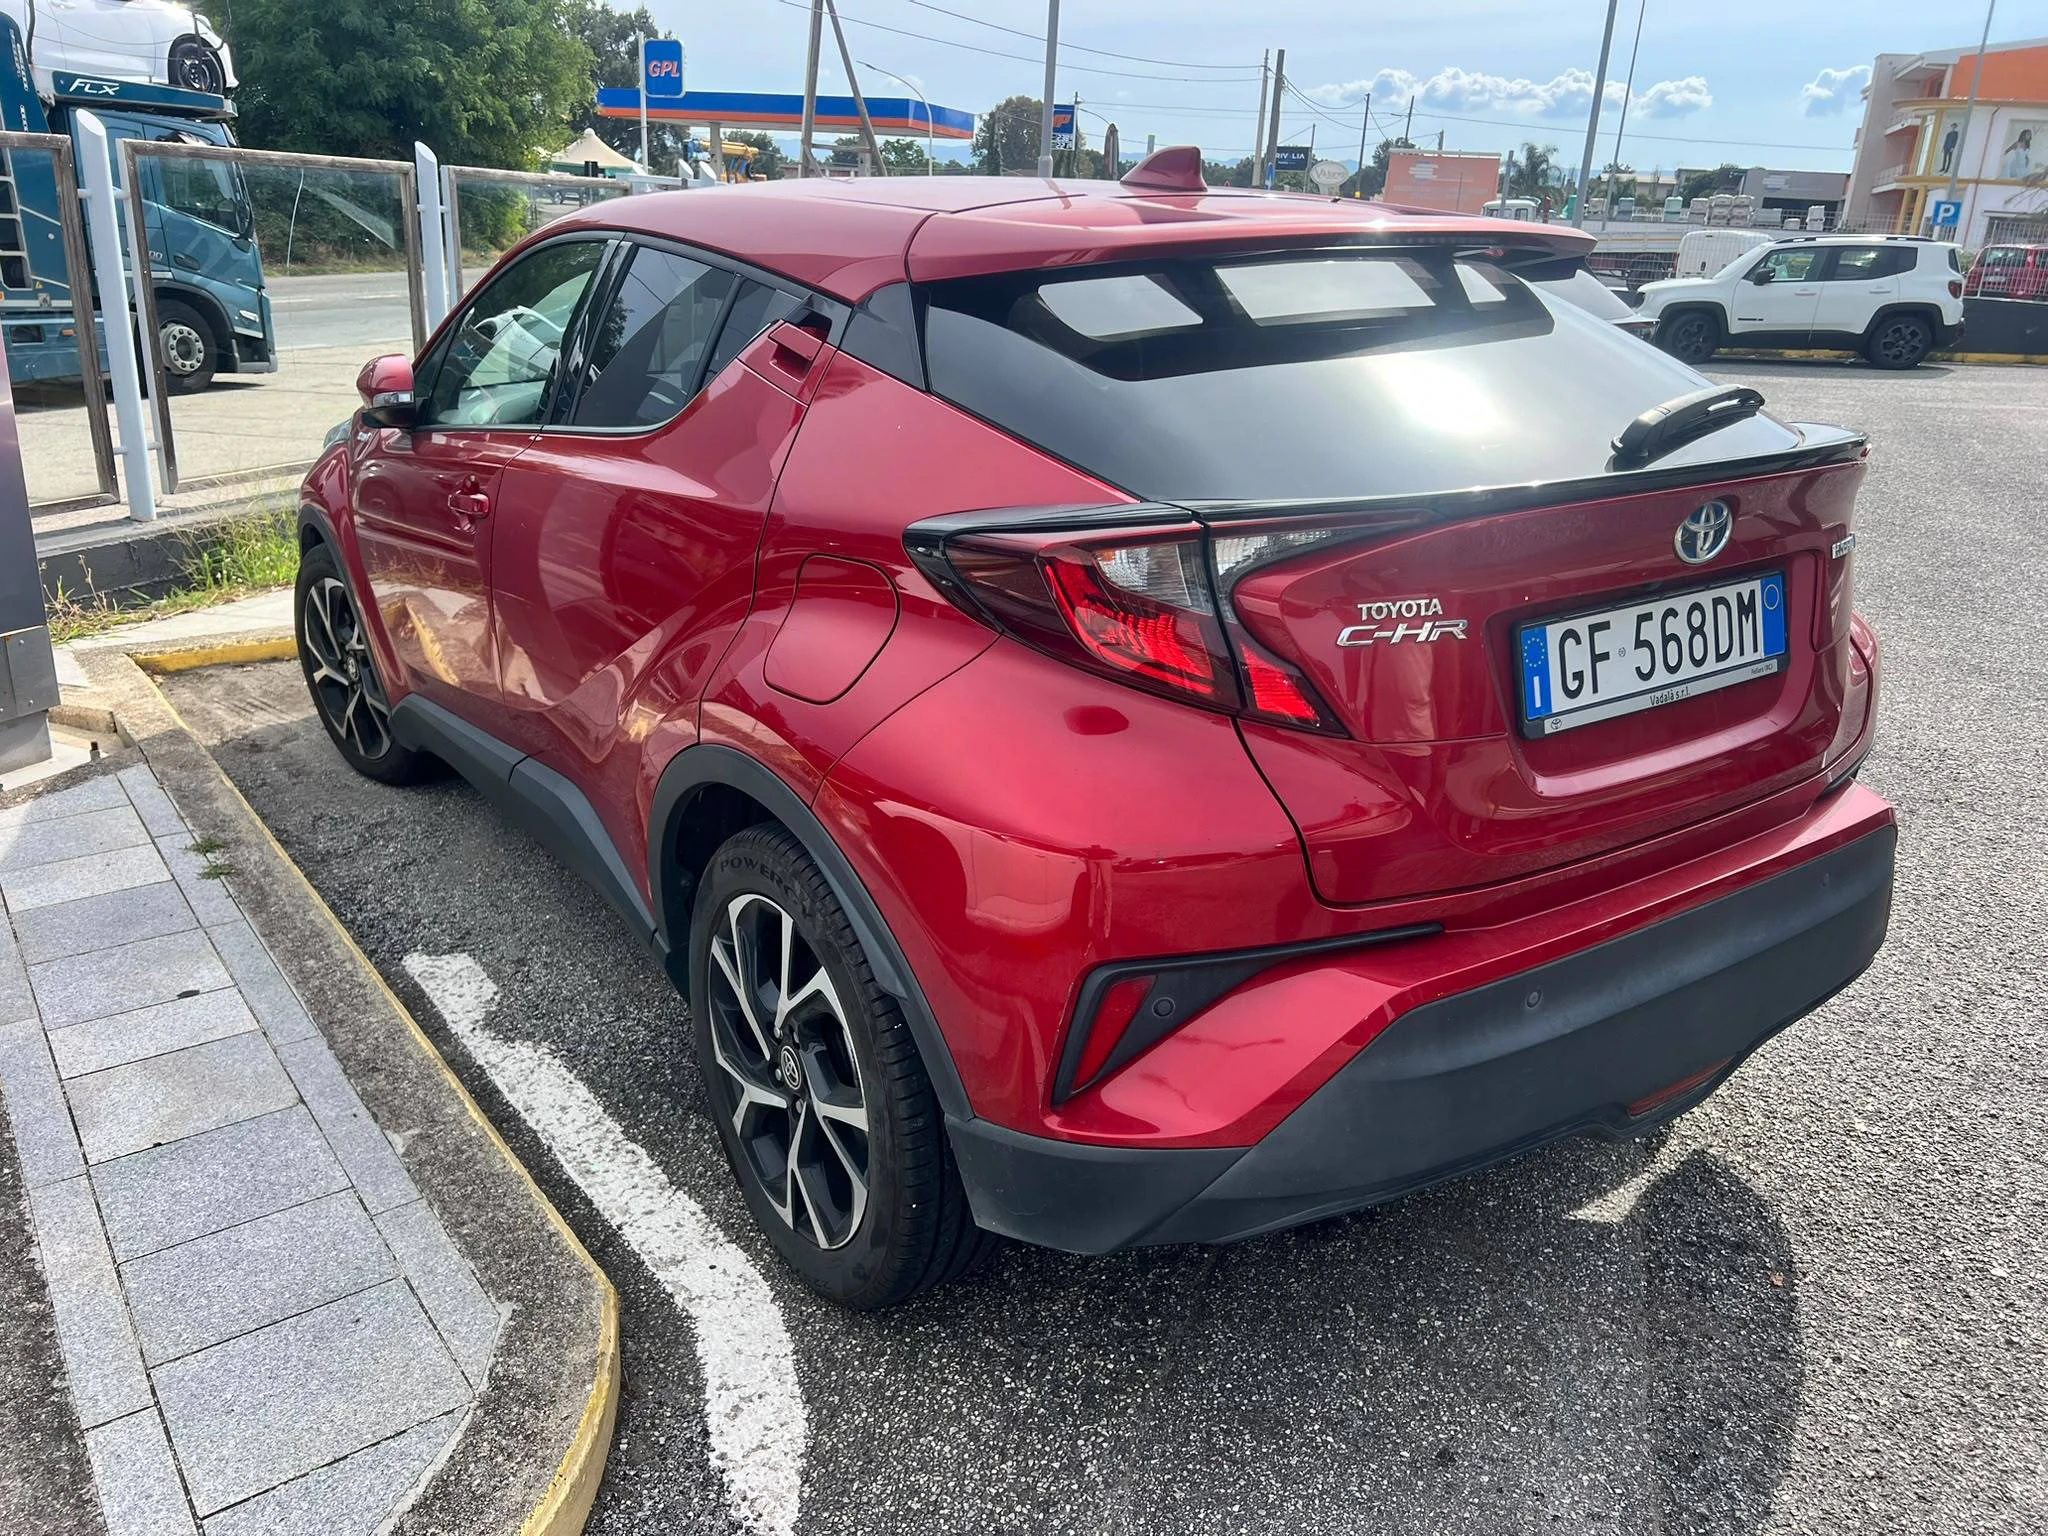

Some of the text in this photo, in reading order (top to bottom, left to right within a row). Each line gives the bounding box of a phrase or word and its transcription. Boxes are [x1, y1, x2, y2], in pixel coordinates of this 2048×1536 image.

[648, 60, 680, 77] GPL
[69, 78, 120, 96] FLX
[1936, 203, 1955, 223] P
[1357, 598, 1443, 621] TOYOTA
[1336, 619, 1469, 647] C-HR
[1558, 588, 1759, 700] GF 568DM
[1649, 689, 1675, 706] Vadalà
